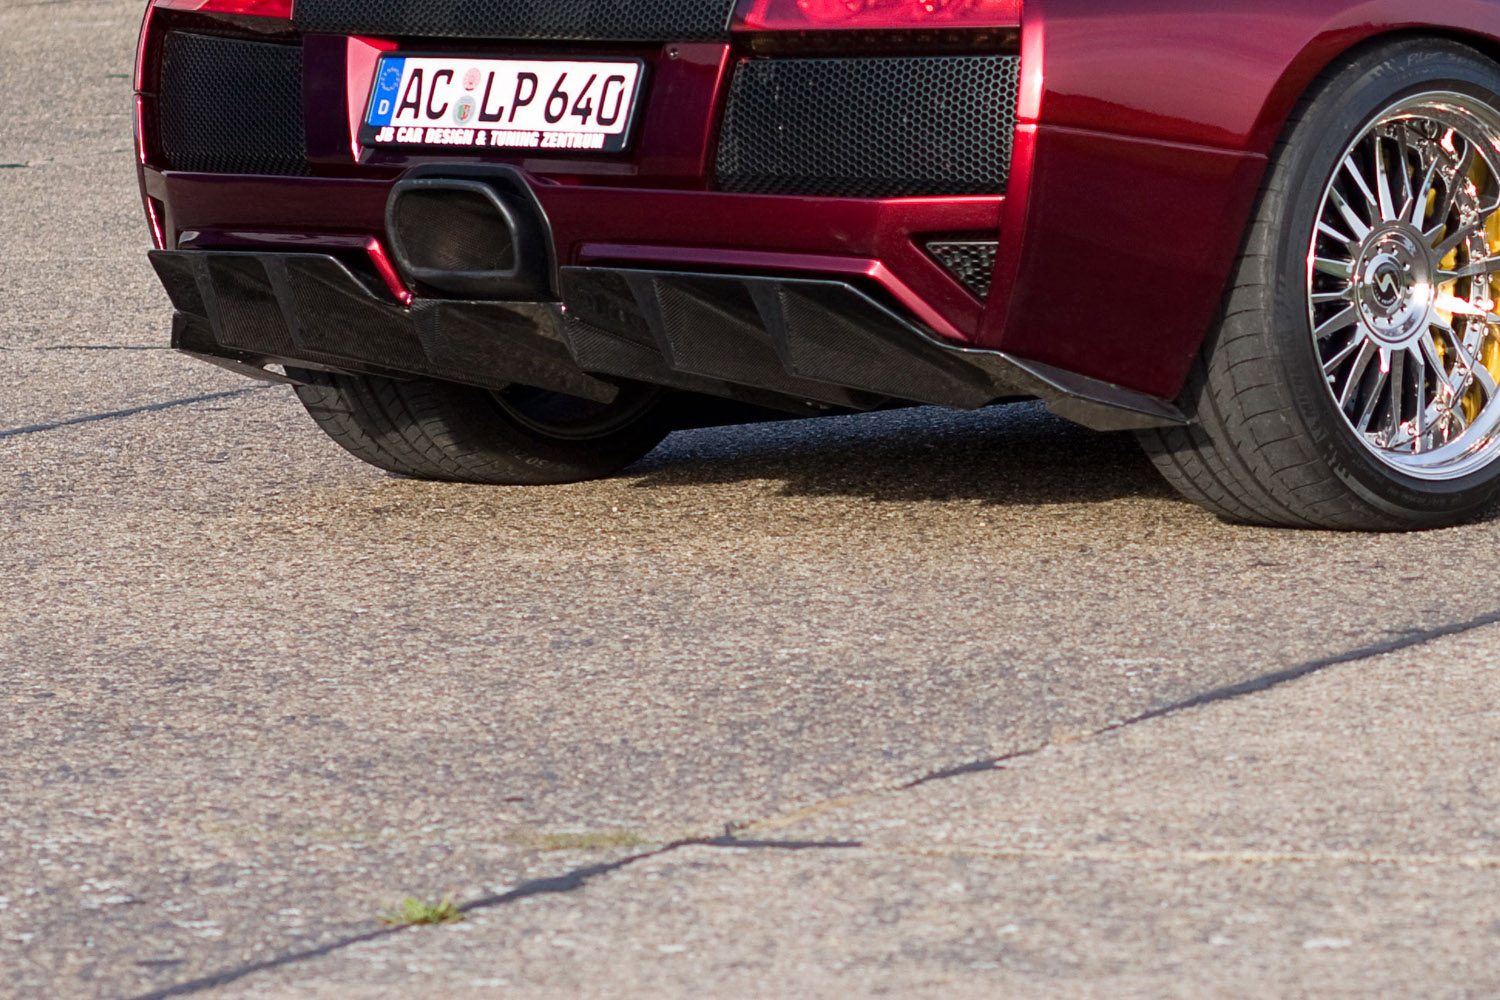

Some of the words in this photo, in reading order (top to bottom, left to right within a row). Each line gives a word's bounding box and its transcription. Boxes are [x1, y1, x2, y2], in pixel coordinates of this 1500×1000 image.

[378, 99, 390, 116] D
[395, 68, 454, 120] AC
[478, 71, 539, 123] LP
[544, 72, 626, 126] 640
[375, 126, 395, 142] JB
[396, 127, 424, 143] CAR
[425, 128, 474, 145] DESIGN
[475, 130, 487, 146] &
[490, 130, 540, 147] TUNING
[540, 132, 605, 149] ZENTRUM
